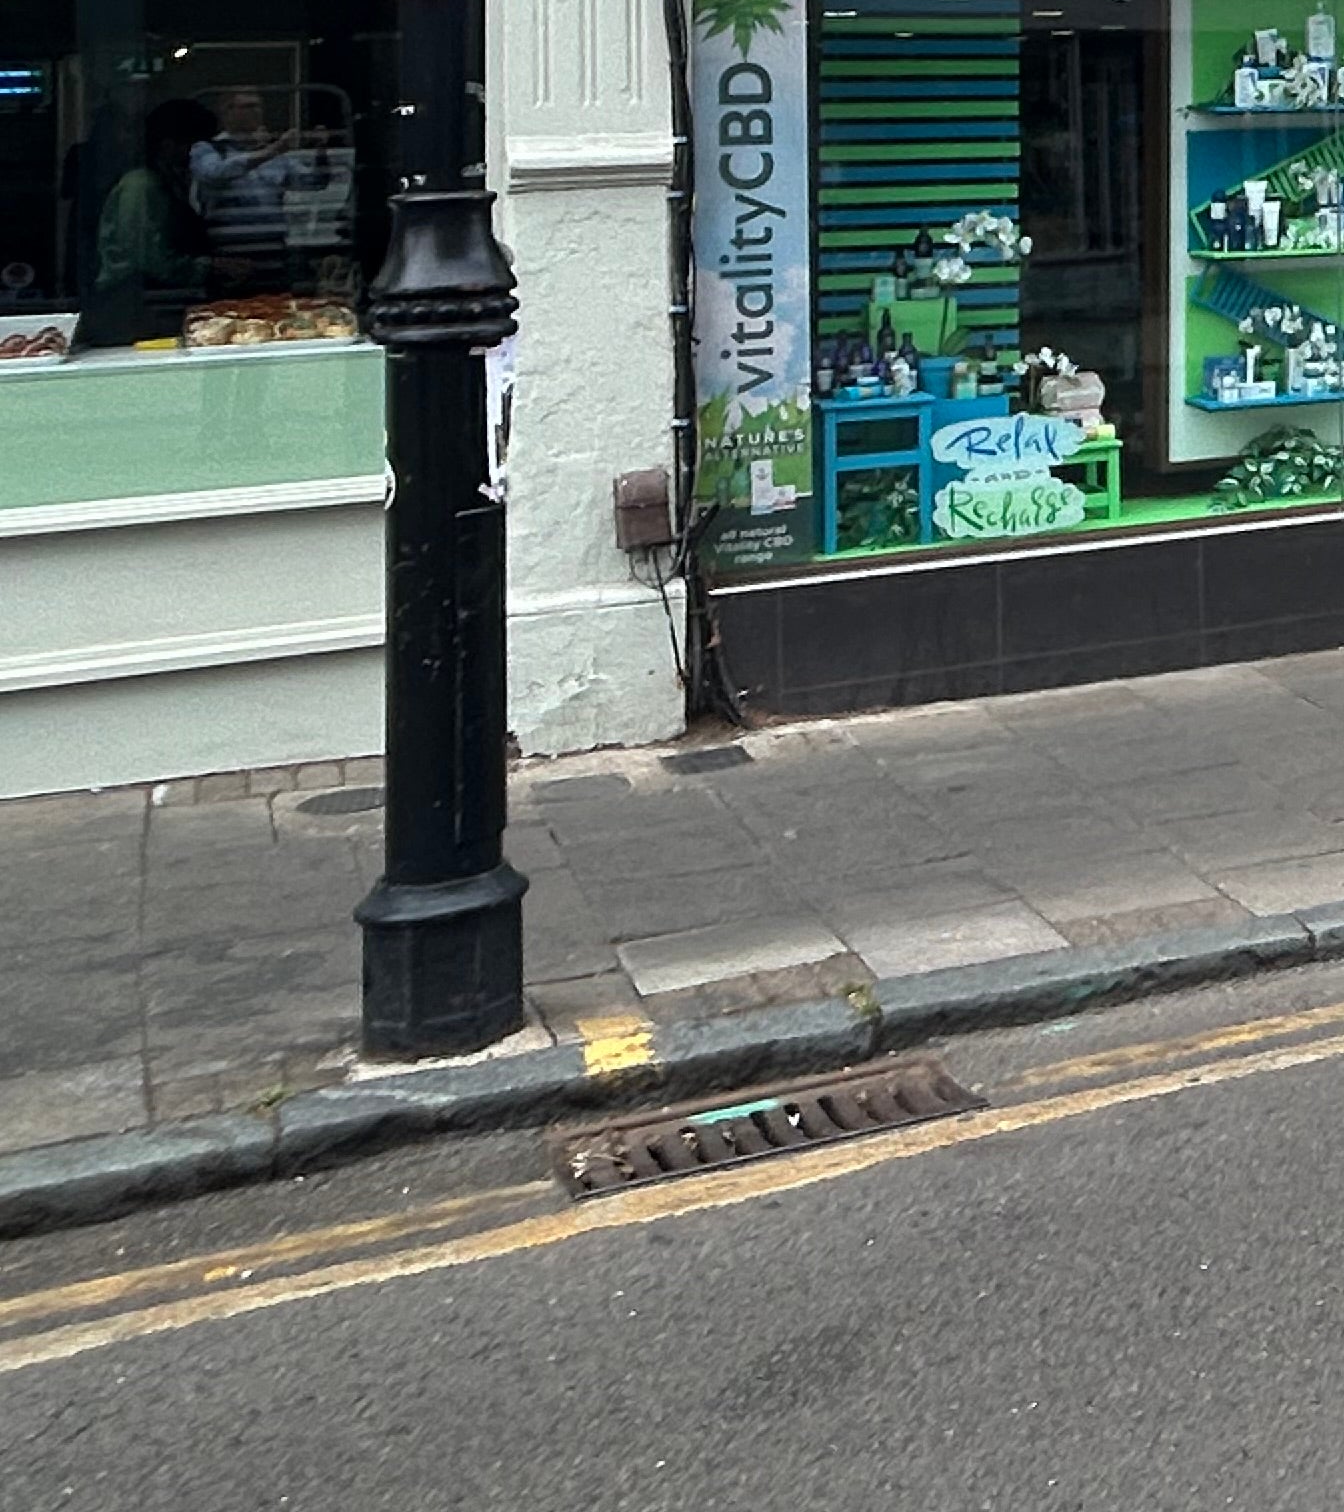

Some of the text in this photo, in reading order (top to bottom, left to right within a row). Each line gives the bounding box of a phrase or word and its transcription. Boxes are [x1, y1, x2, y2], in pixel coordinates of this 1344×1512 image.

[719, 61, 787, 394] vitalityCBD
[945, 416, 1060, 461] Relax
[948, 485, 1073, 533] Recharge
